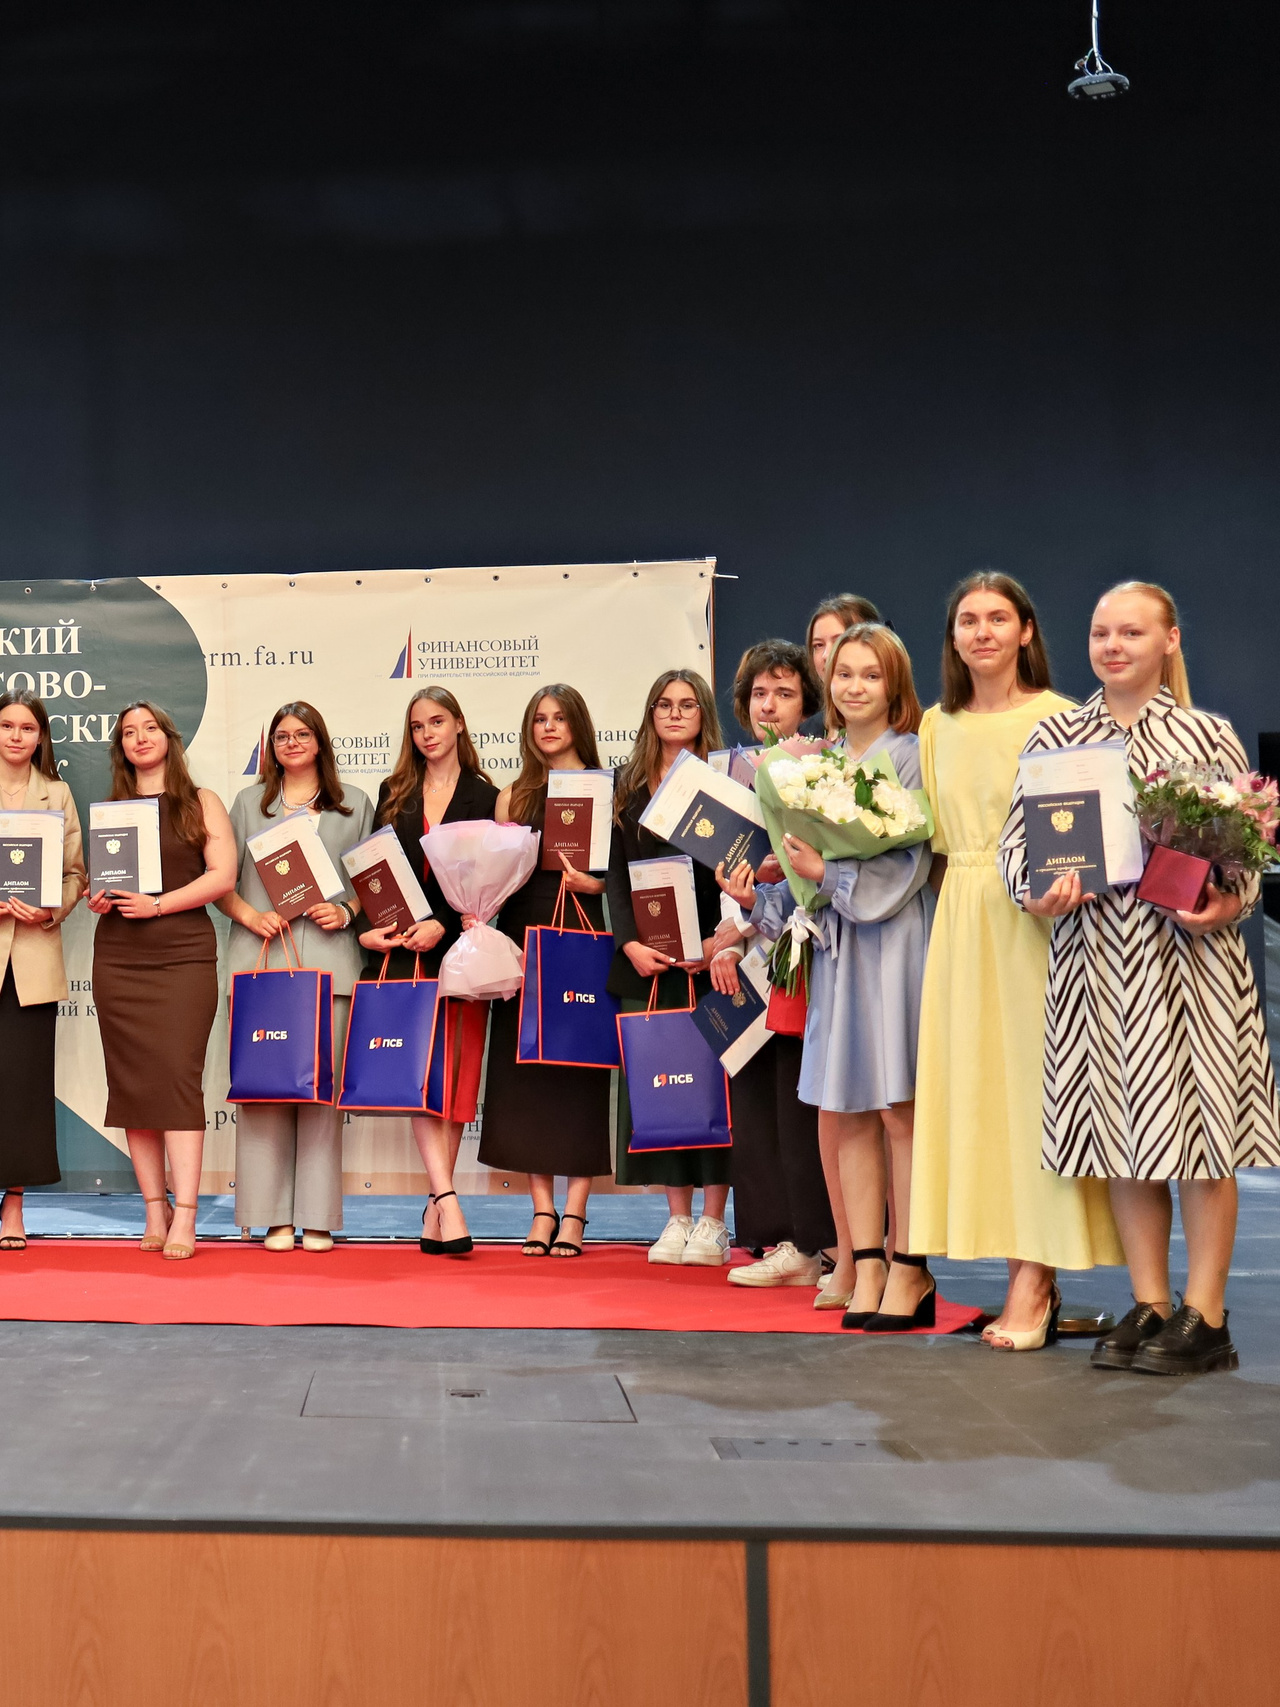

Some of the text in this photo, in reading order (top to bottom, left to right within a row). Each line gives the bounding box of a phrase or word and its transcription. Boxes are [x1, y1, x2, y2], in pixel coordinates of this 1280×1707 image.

[417, 635, 540, 654] ФИНАНСОВЫЙ
[204, 645, 314, 667] rm.fa.ru
[417, 655, 540, 670] УНИВЕРСИТЕТ
[331, 732, 390, 749] СОВЫЙ
[1046, 856, 1086, 866] ДИПЛОМ
[282, 883, 306, 899] ДИПЛОМ
[575, 993, 596, 1004] ПСБ
[265, 1031, 288, 1040] ПСБ
[382, 1039, 403, 1047] ПСБ
[668, 1074, 694, 1085] ПСБ
